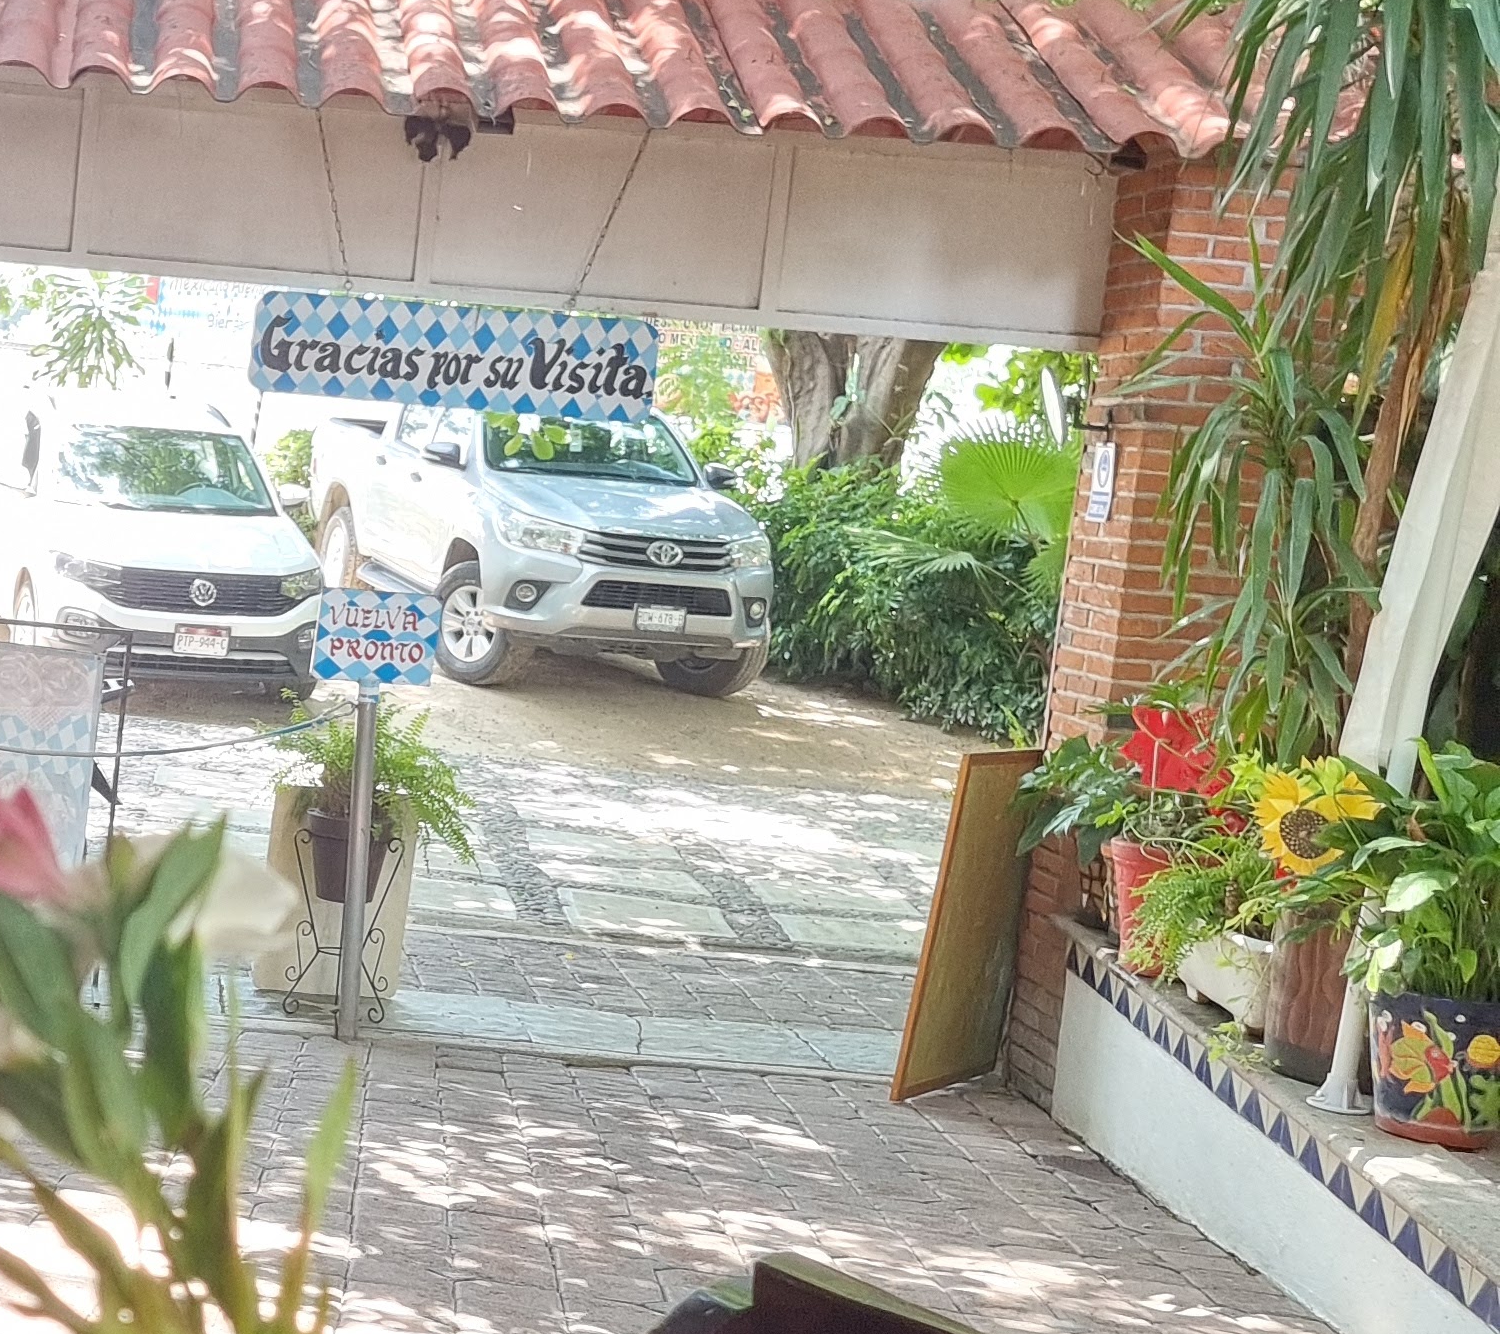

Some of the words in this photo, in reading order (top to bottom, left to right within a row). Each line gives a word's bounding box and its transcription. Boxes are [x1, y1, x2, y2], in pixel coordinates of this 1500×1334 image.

[260, 313, 422, 382] Gracias
[427, 350, 483, 390] por
[483, 353, 524, 391] su
[528, 336, 652, 400] Visita
[330, 603, 419, 632] VUELVA
[177, 634, 227, 650] PTP-944-C
[329, 636, 424, 664] PRONTO
